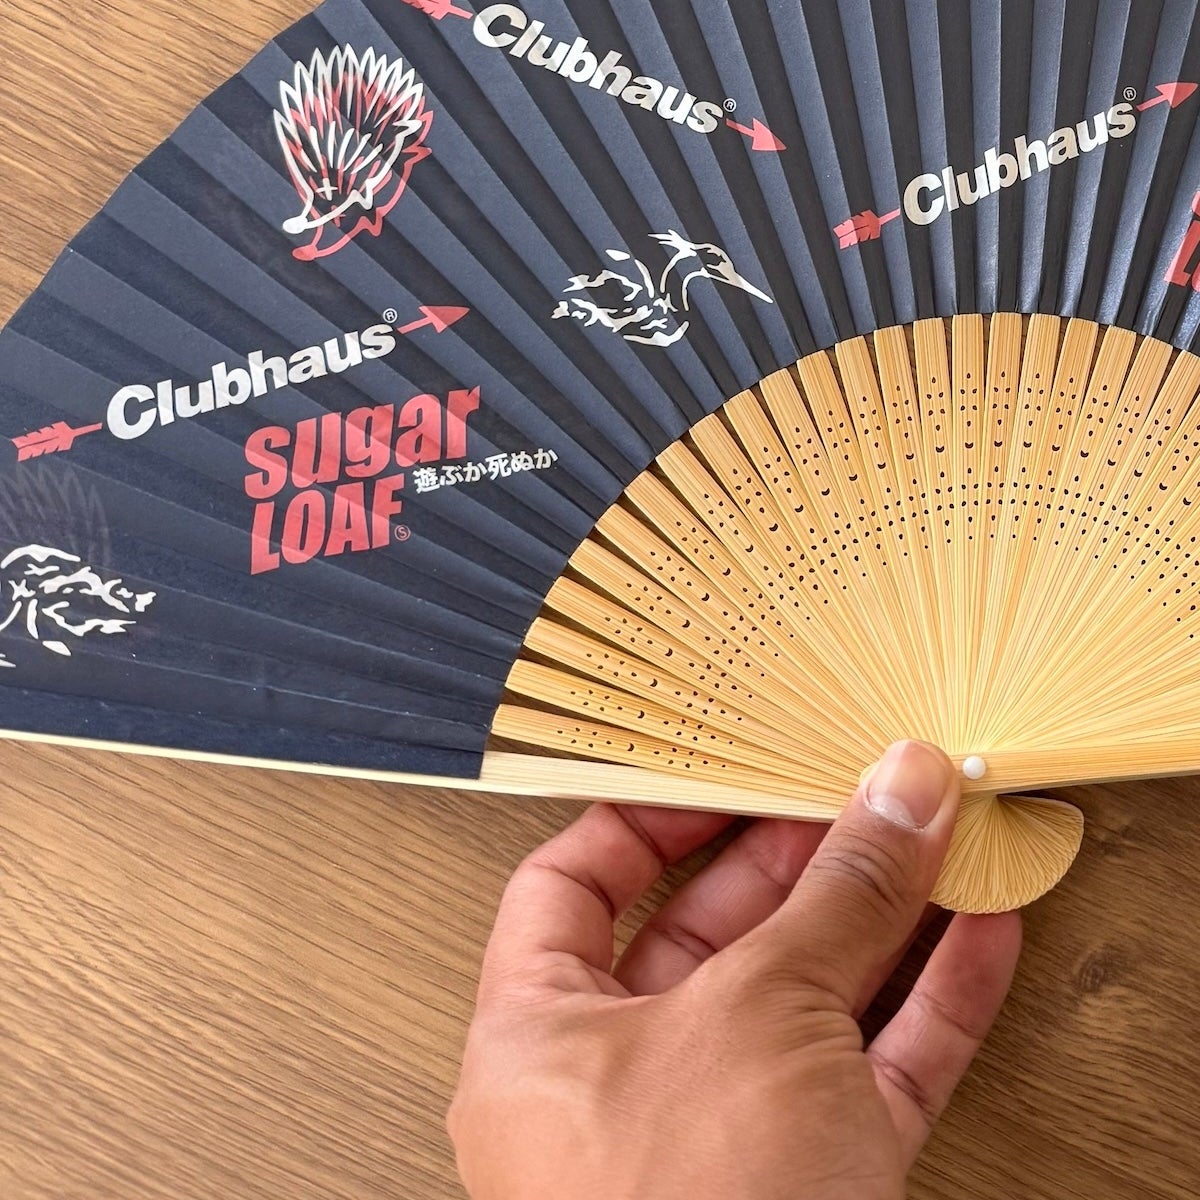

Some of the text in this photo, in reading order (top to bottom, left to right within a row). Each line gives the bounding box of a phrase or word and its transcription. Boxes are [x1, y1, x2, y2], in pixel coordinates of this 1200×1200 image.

[244, 385, 481, 499] sugar
[412, 448, 559, 494] 遊ぶか死ぬか
